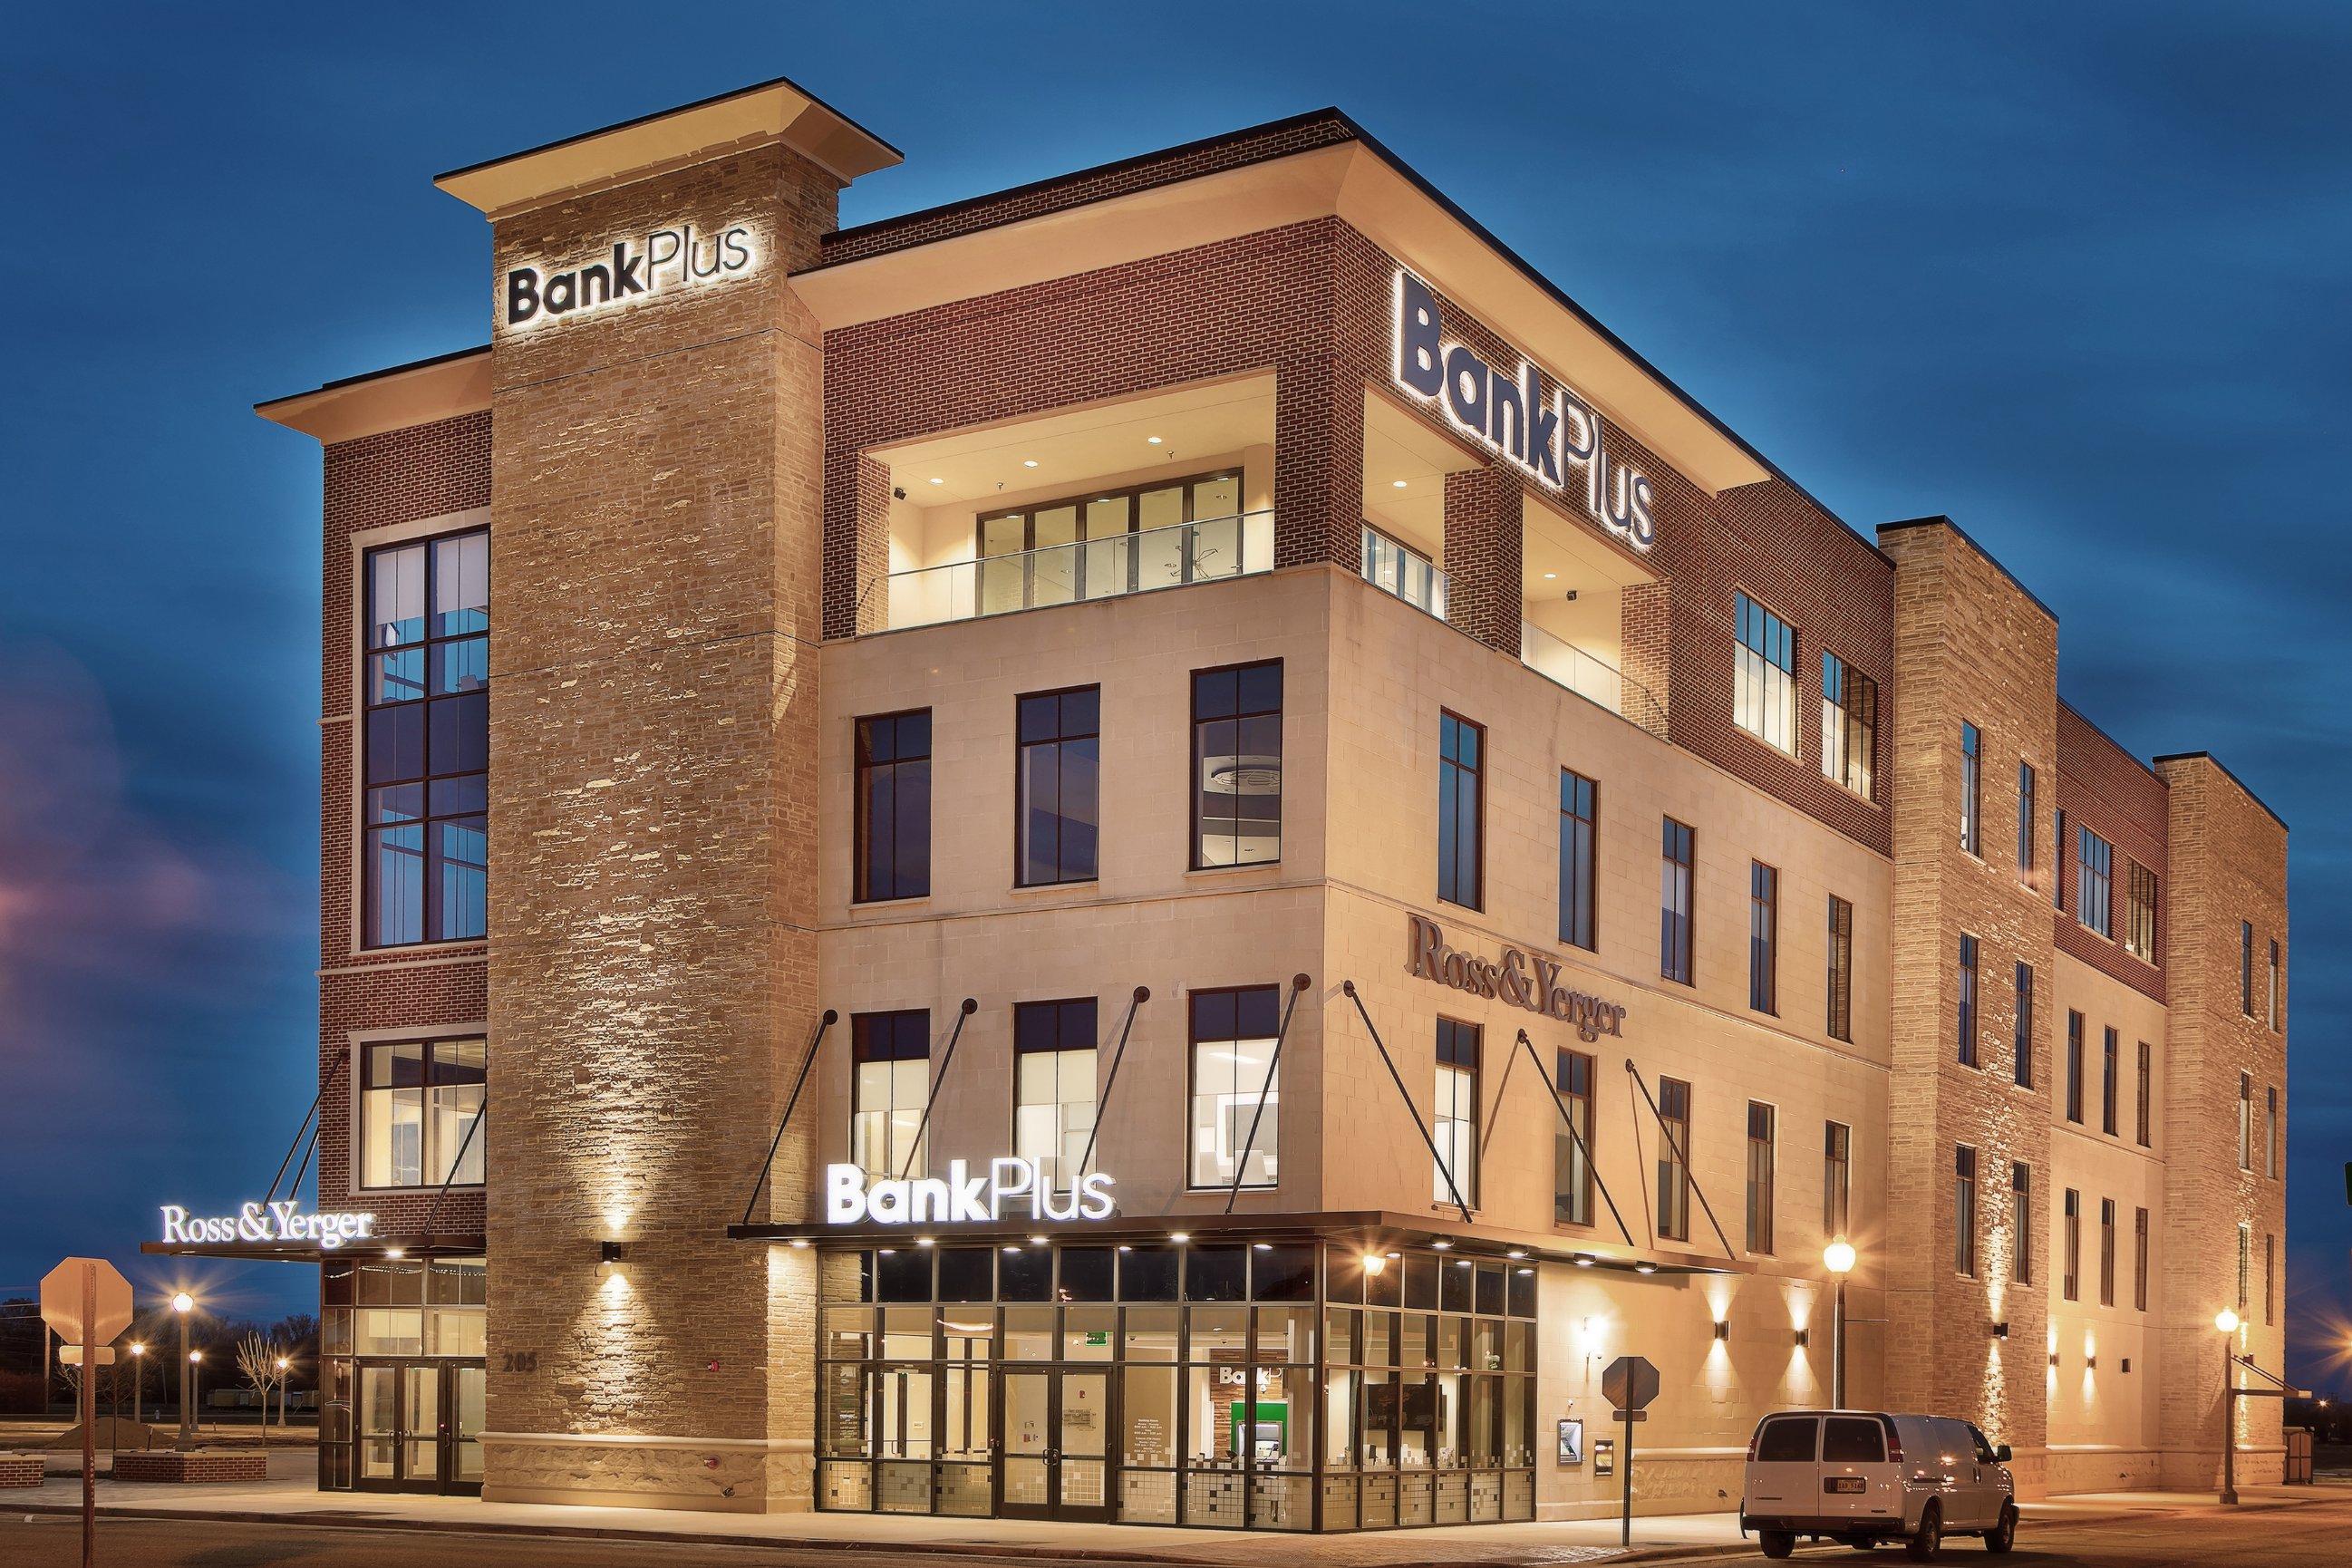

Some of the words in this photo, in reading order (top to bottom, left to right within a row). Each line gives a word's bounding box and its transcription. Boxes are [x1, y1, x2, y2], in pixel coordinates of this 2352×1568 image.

[508, 225, 749, 324] BankPlus
[1399, 272, 1655, 545] BankPlus
[1404, 912, 1627, 1042] Ross&Yerger
[160, 1200, 377, 1249] Ross&Yerger
[826, 1156, 1118, 1224] BankPlus
